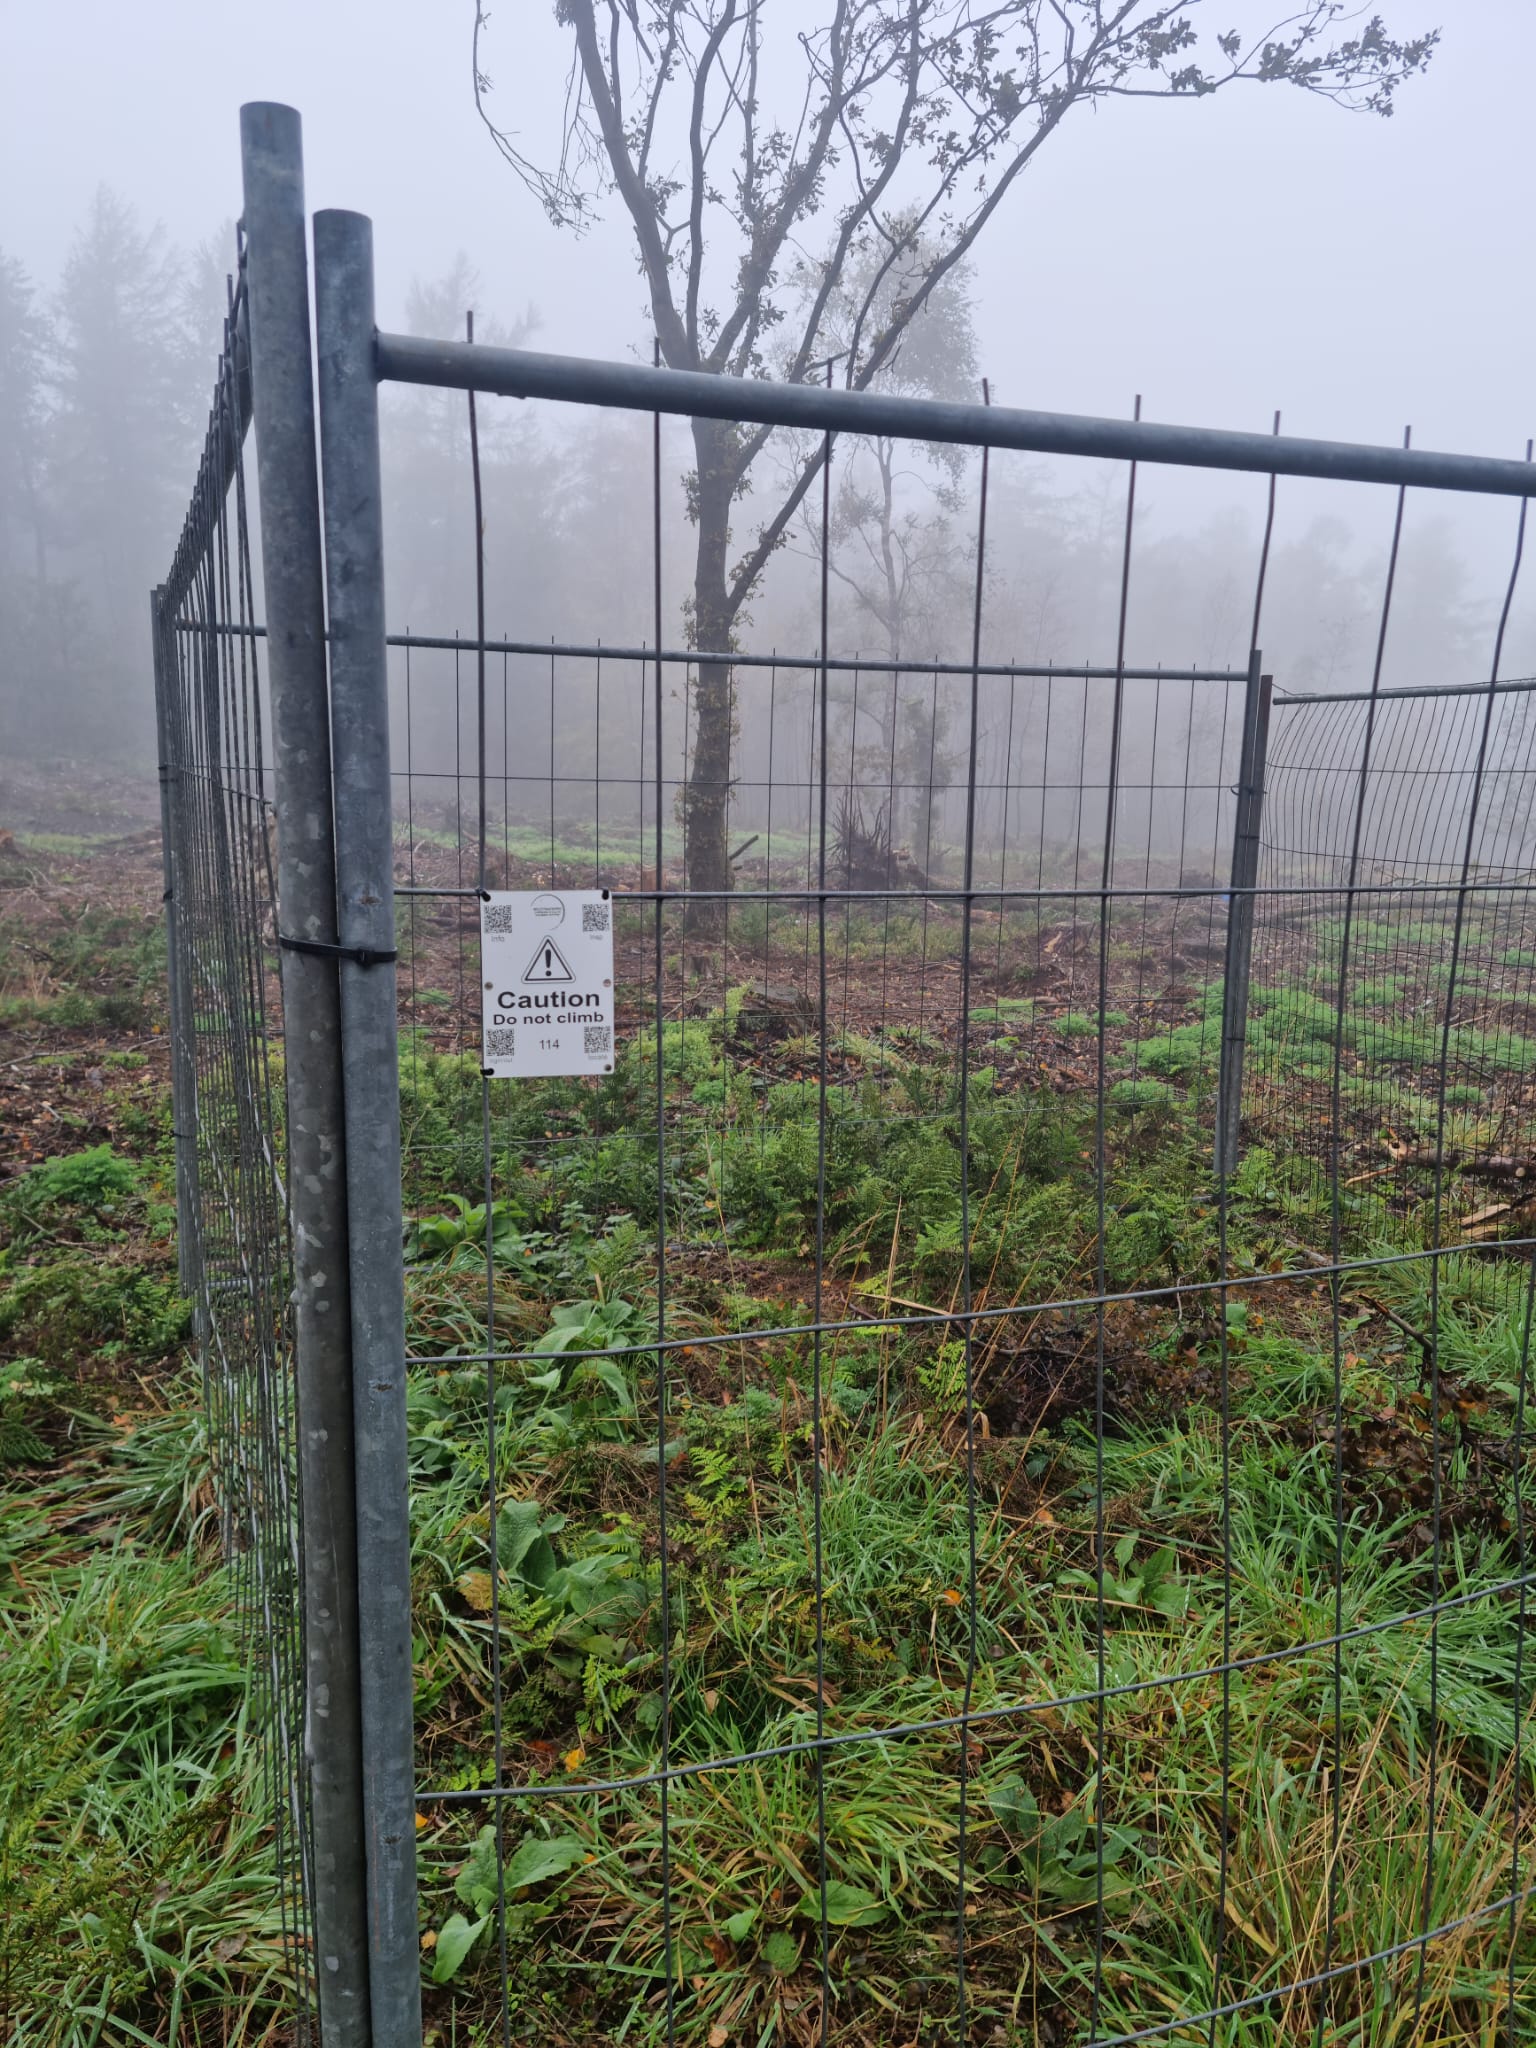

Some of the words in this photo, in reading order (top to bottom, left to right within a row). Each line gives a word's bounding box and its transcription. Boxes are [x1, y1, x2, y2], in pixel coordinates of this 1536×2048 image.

[497, 991, 600, 1009] Caution
[493, 1014, 517, 1025] Do
[523, 1012, 552, 1025] not
[557, 1011, 604, 1024] climb
[539, 1039, 560, 1050] 114
